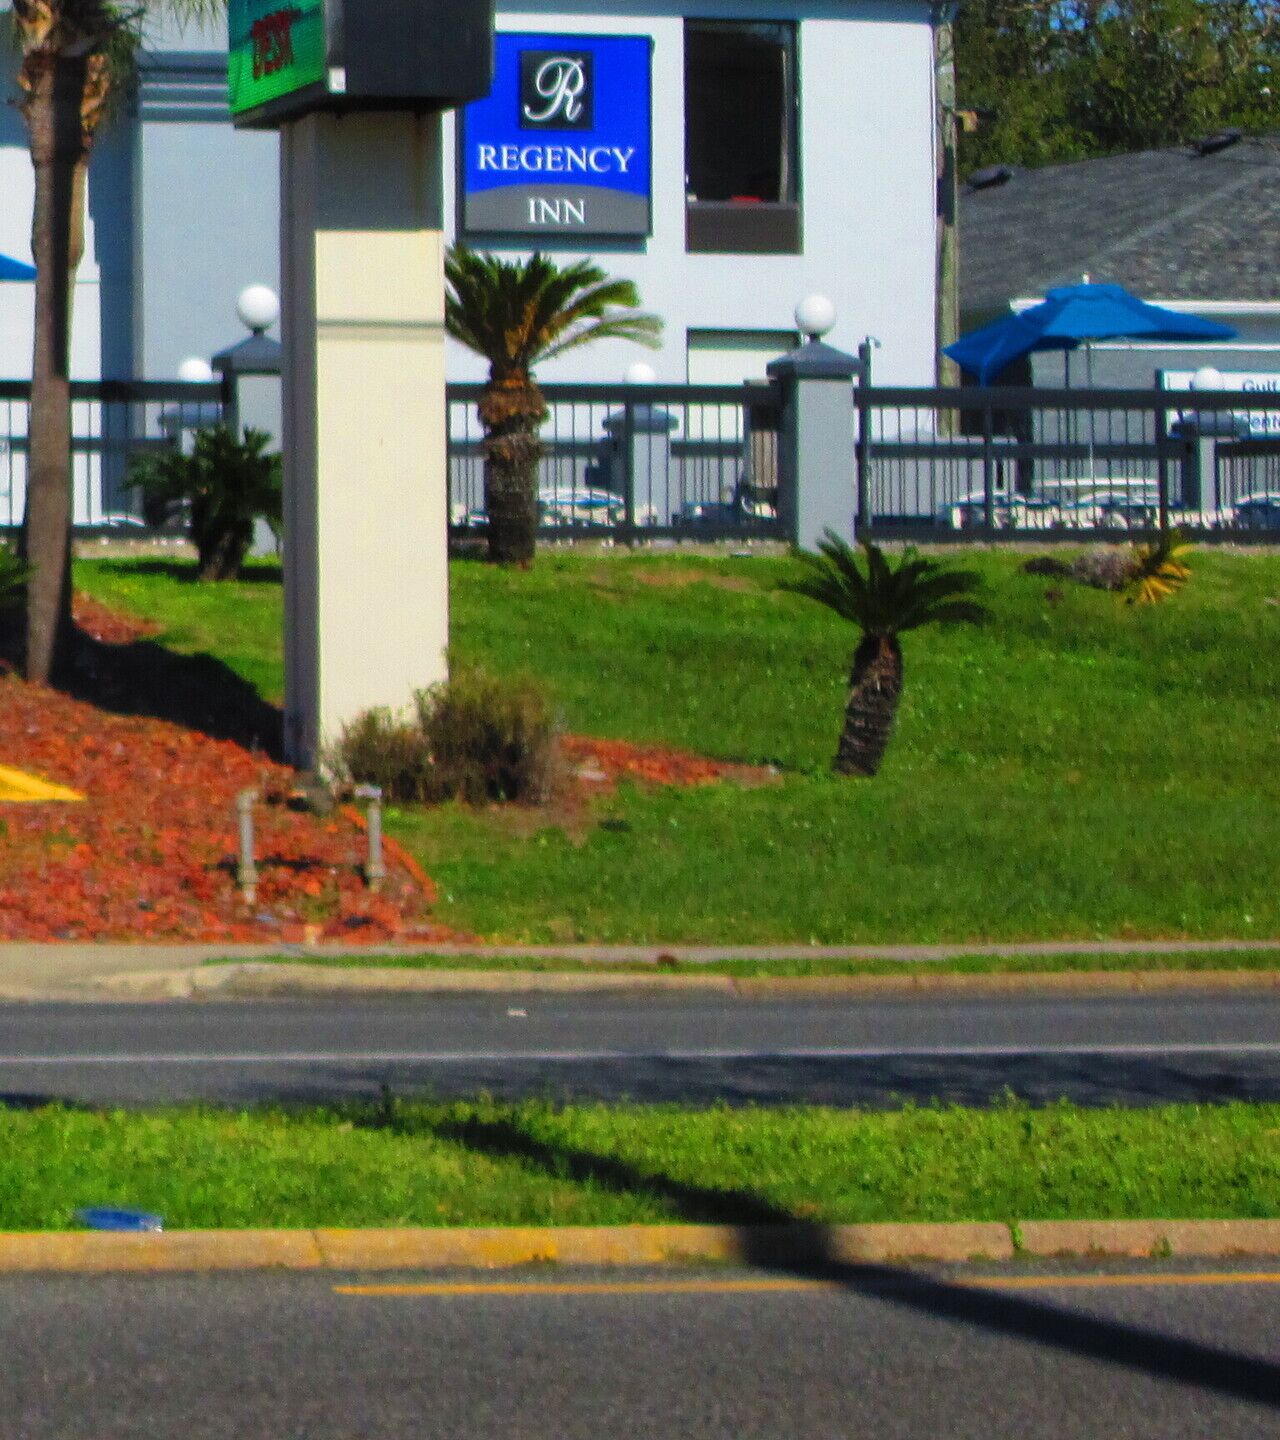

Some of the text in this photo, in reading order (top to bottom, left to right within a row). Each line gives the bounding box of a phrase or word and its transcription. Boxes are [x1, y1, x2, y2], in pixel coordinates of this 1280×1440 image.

[524, 58, 585, 121] R
[478, 144, 633, 172] REGENCY
[529, 199, 586, 224] INN
